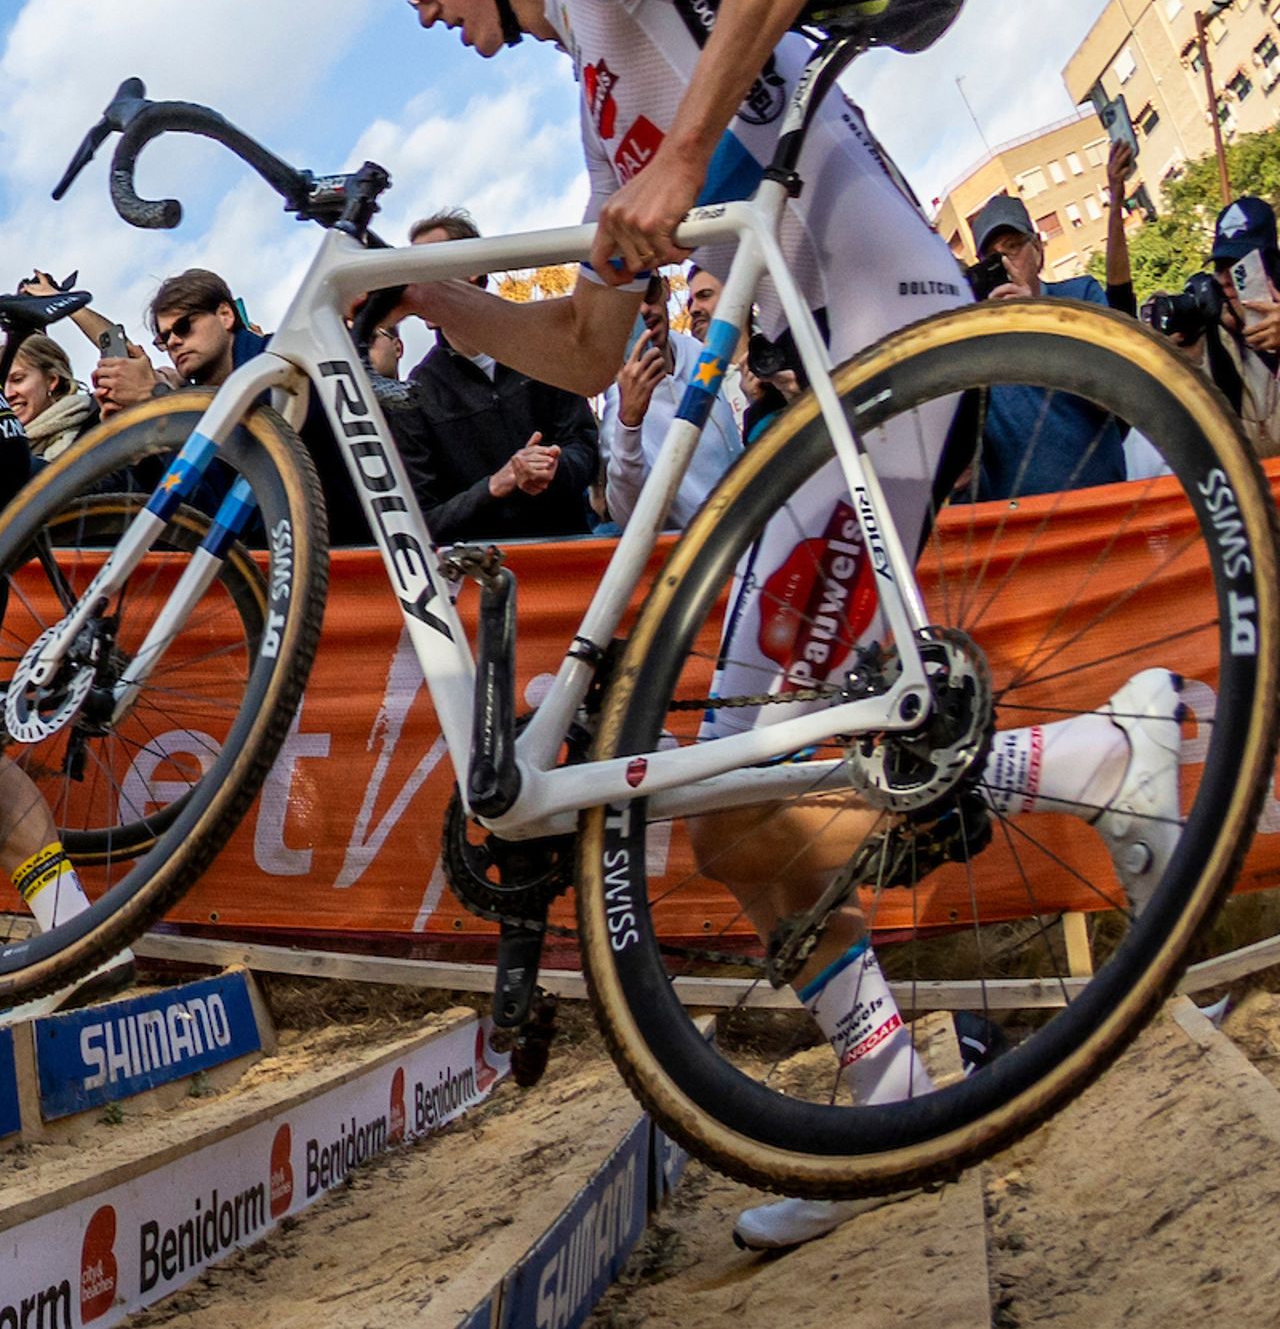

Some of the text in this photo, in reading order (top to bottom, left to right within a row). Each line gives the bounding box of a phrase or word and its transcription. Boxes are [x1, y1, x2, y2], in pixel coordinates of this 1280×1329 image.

[898, 280, 960, 296] DOLTCINI
[317, 359, 457, 643] RIDLEY
[855, 486, 894, 582] RIDLEY
[1198, 468, 1252, 579] SWISS
[271, 519, 292, 602] SWISS
[787, 519, 864, 688] Pauwels
[261, 609, 286, 658] DT
[1228, 590, 1257, 656] DT
[603, 849, 639, 952] SWISS
[79, 991, 232, 1091] SHIMANO
[415, 1066, 477, 1131] Benidorm
[306, 1115, 388, 1199] Benidorm
[141, 1182, 266, 1294] Benidorm
